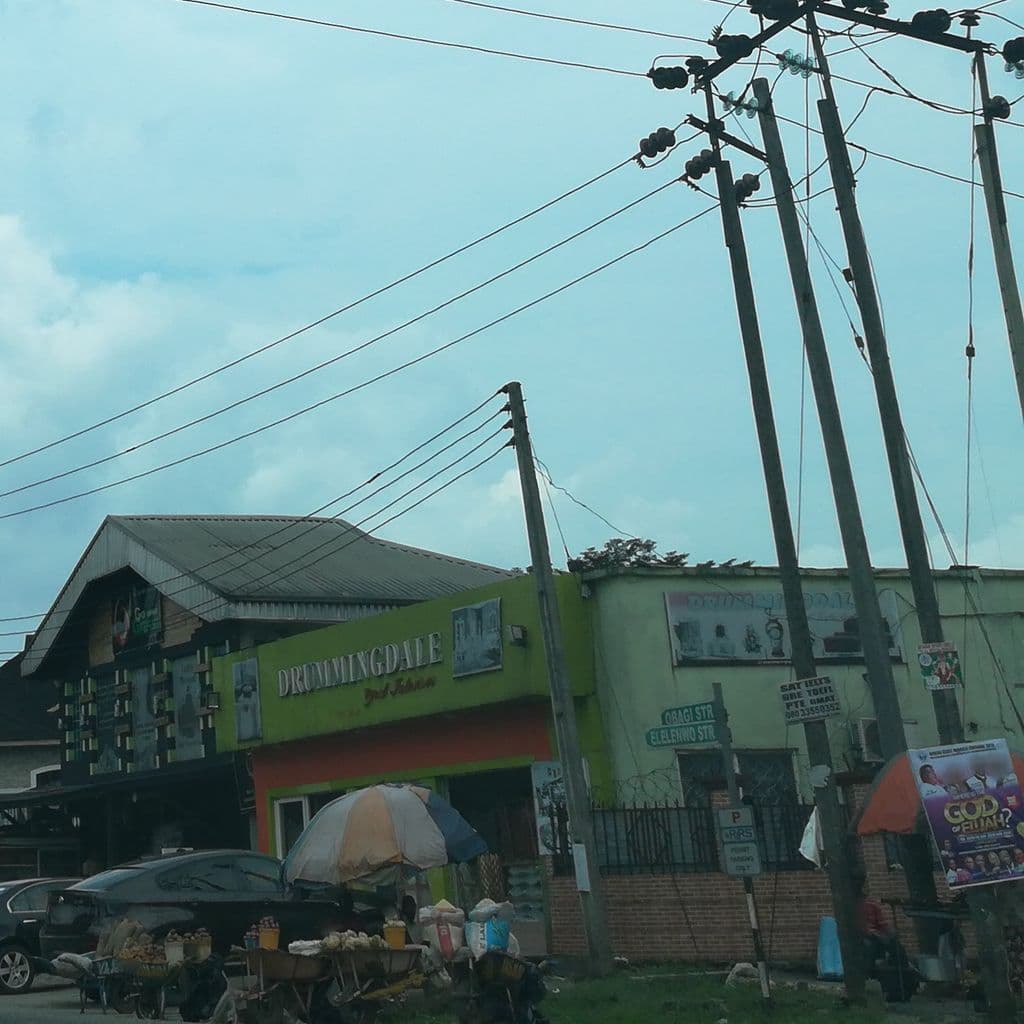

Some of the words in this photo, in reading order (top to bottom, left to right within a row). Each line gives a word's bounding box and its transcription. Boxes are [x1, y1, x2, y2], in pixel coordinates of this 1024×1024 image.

[277, 632, 442, 697] DRUMMINGDALE
[780, 682, 801, 693] SAT
[785, 699, 806, 711] PTE
[665, 707, 693, 725] OBAGI
[695, 704, 714, 721] STR
[697, 724, 716, 741] STR
[731, 810, 741, 824] P
[944, 795, 999, 824] GOD
